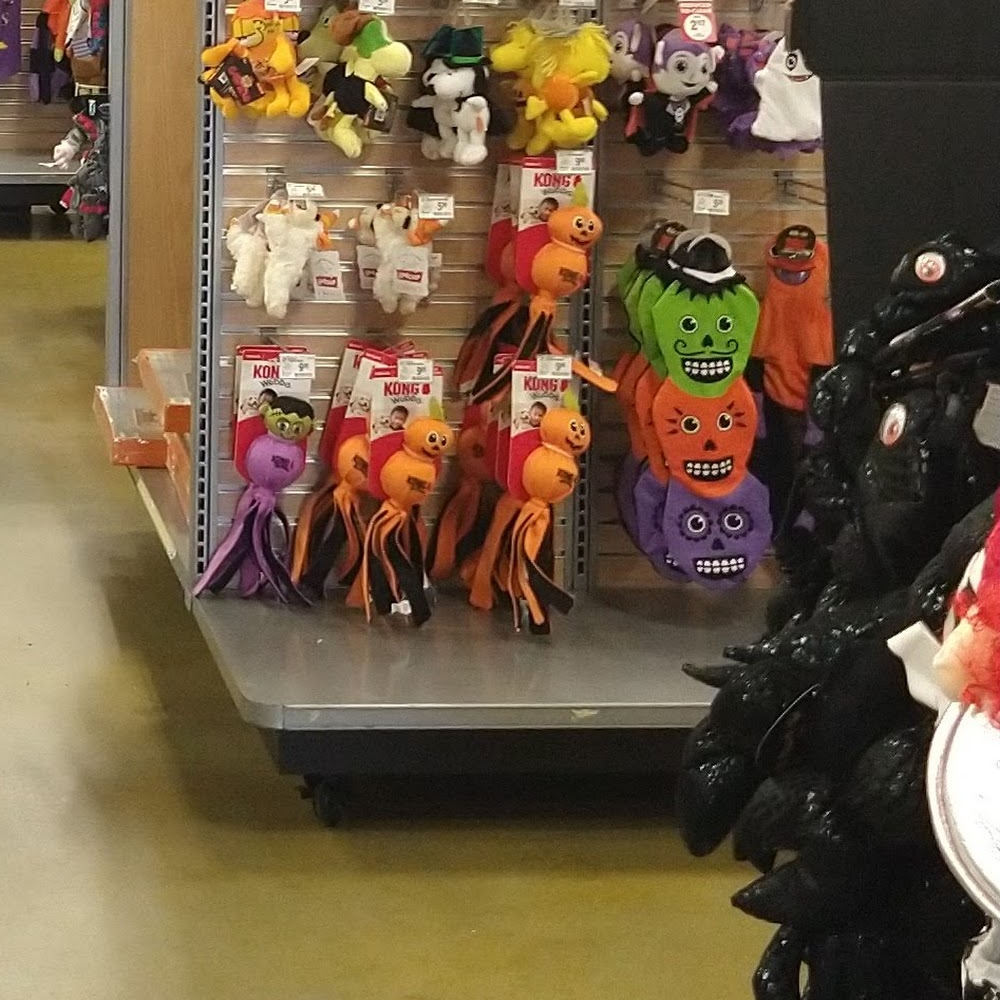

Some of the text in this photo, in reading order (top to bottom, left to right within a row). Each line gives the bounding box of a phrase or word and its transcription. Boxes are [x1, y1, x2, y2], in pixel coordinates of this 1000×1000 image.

[534, 173, 570, 187] KONG
[253, 365, 280, 379] KON
[384, 382, 420, 396] KONG
[524, 376, 557, 391] KONG
